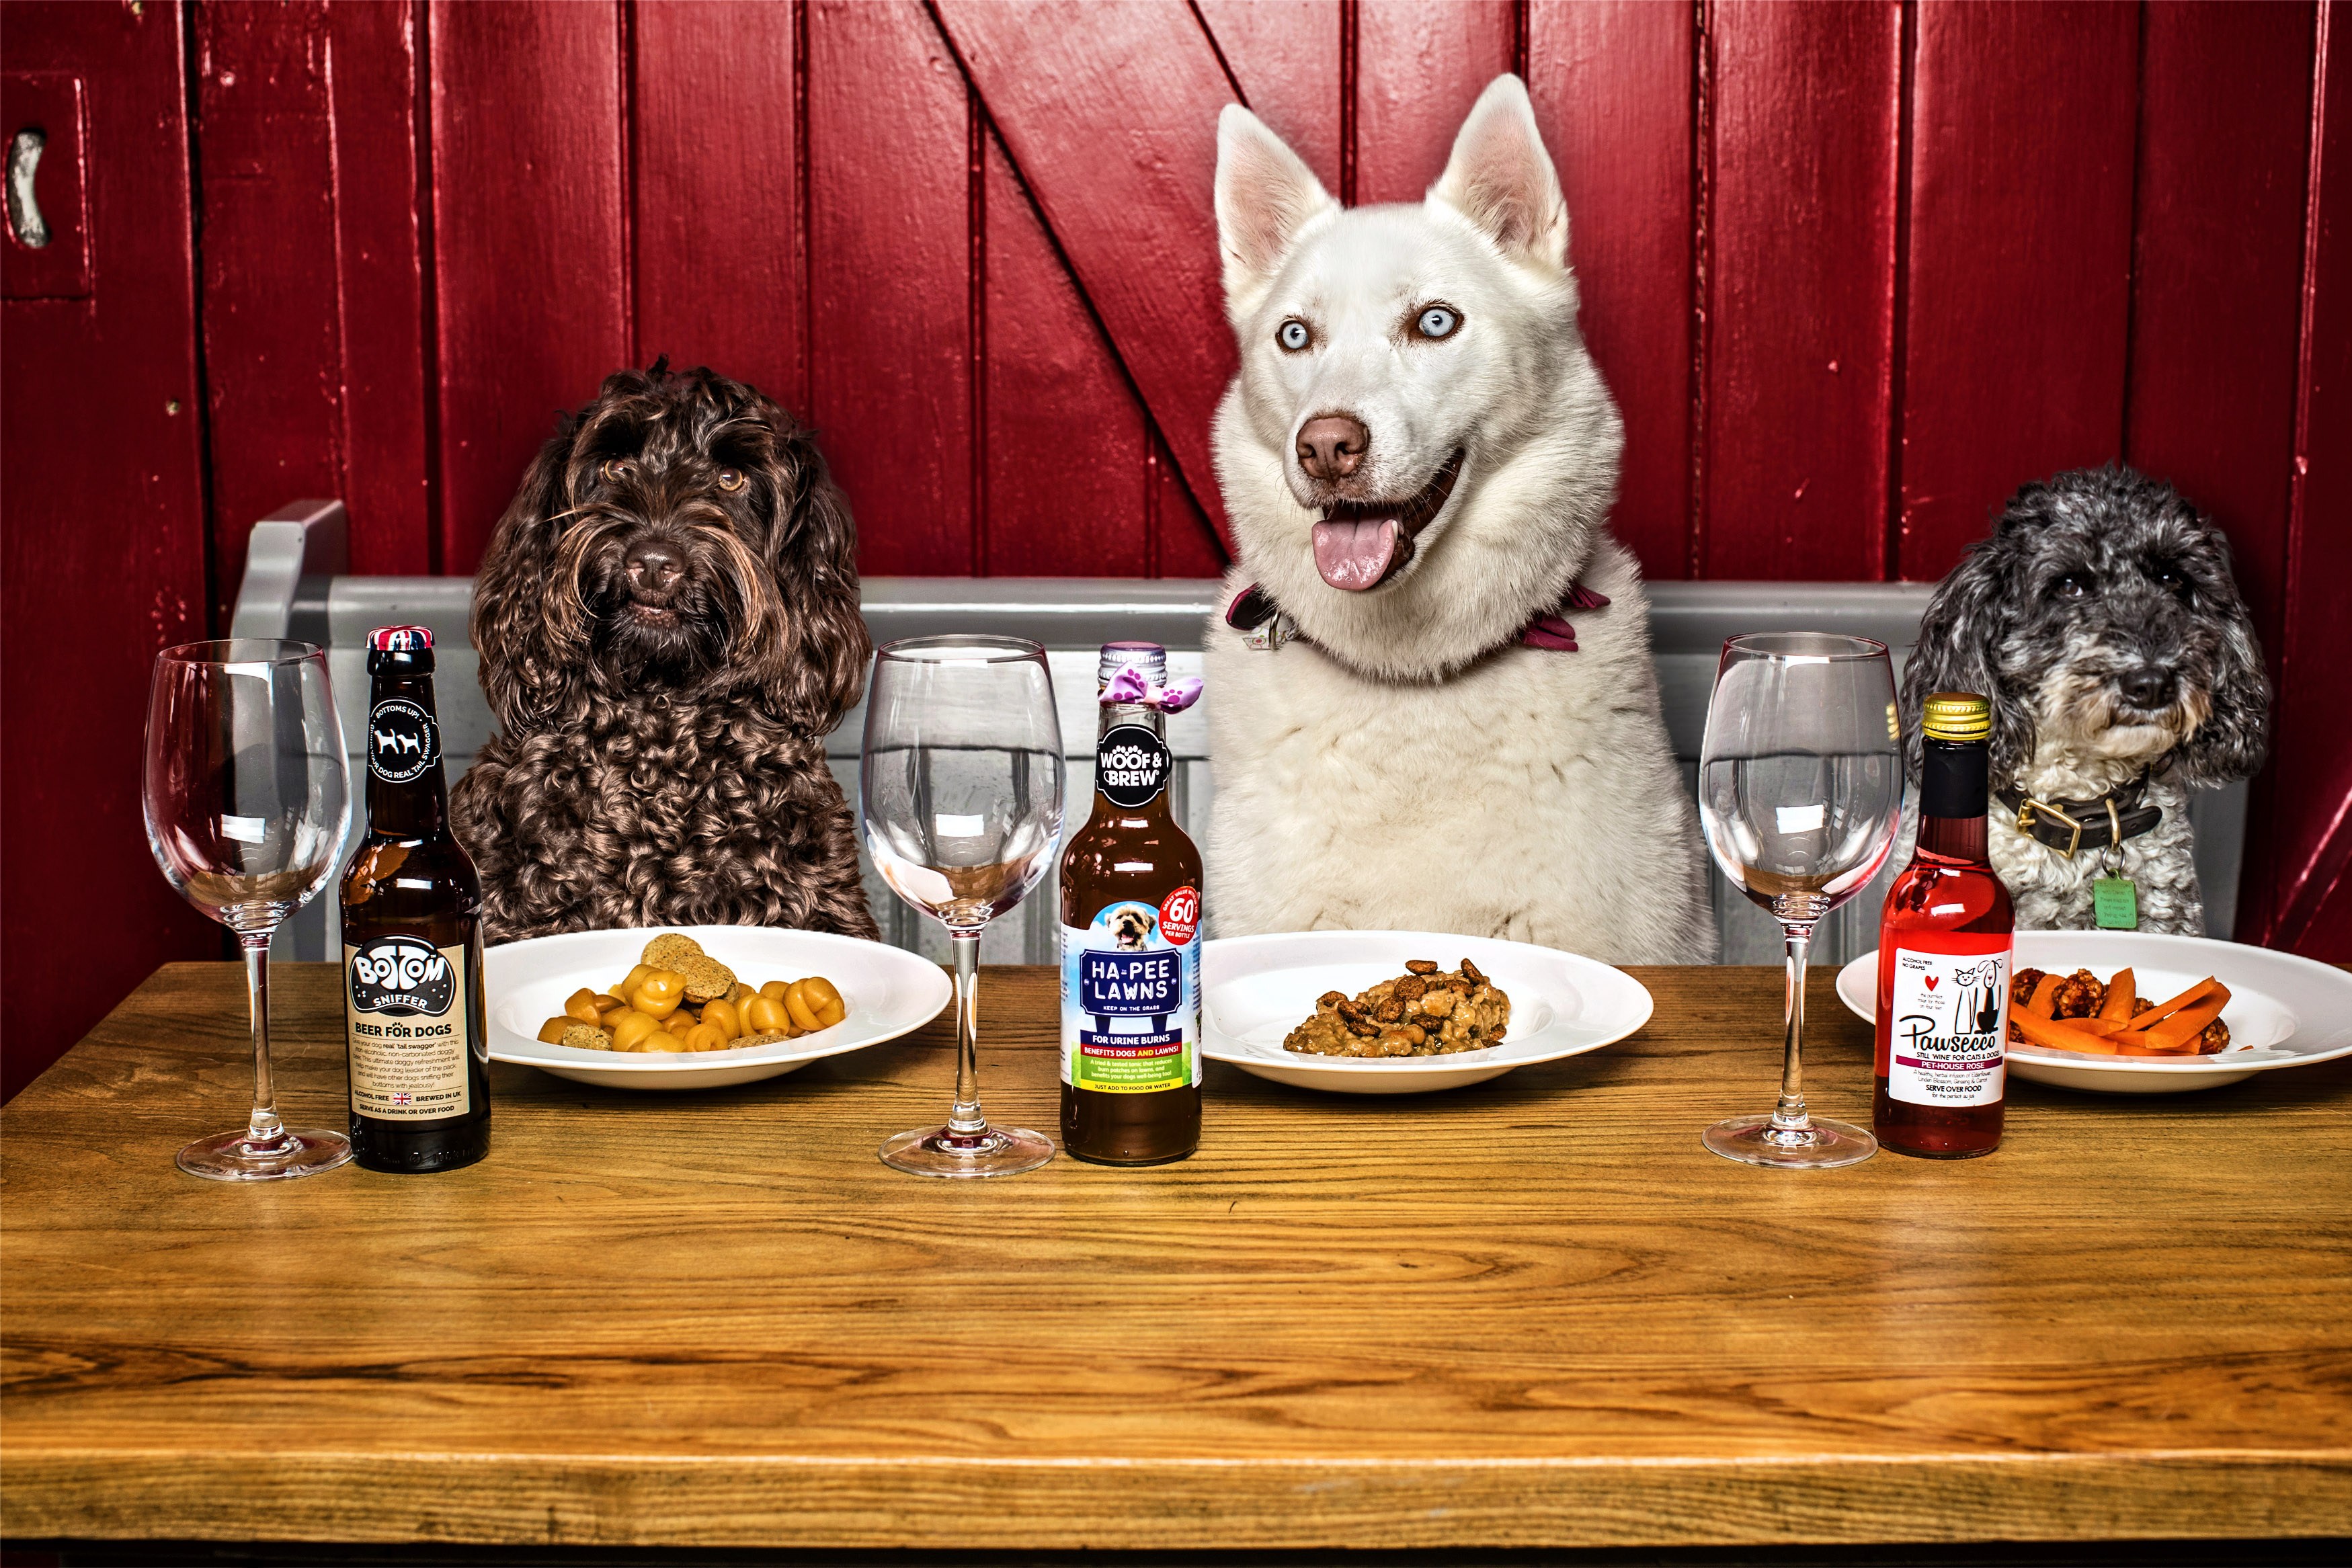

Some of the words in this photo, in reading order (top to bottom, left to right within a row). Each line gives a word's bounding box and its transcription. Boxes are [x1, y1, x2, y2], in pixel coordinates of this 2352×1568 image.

[376, 705, 407, 718] BOTTOMS
[407, 708, 420, 718] UP!
[378, 767, 393, 778] DOG
[393, 770, 413, 778] REAL
[411, 761, 425, 772] TAIL
[421, 723, 431, 760] SWAGGER
[1100, 752, 1150, 770] WOOF
[1152, 752, 1162, 768] &
[1104, 770, 1157, 786] BREW
[1162, 895, 1175, 911] GREAT
[1170, 897, 1194, 923] 60
[1162, 921, 1194, 933] SERVINGS
[354, 945, 446, 990] BOTTOM
[1092, 959, 1170, 980] HA-PEE
[1095, 980, 1168, 1000] LAWNS
[372, 994, 428, 1009] SNIFFER
[355, 1022, 382, 1036] BEER
[385, 1024, 412, 1037] FOR
[415, 1024, 452, 1037] DOGS
[1899, 1014, 1996, 1053] Pawsecco
[1092, 1035, 1108, 1044] FOR
[1110, 1036, 1139, 1044] URINE
[1141, 1034, 1170, 1044] BURNS
[1084, 1046, 1114, 1057] BENEFITS
[1155, 1045, 1178, 1055] LAWNS!
[1987, 1050, 1999, 1059] DOGS
[415, 1057, 450, 1065] refreshment
[1921, 1061, 1965, 1070] PET-HOUSE
[1966, 1062, 1985, 1070] ROSE
[372, 1080, 395, 1088] bottoms
[1926, 1084, 1945, 1092] SERVE
[355, 1089, 374, 1099] ALCOHOL
[360, 1104, 374, 1112] SERVE
